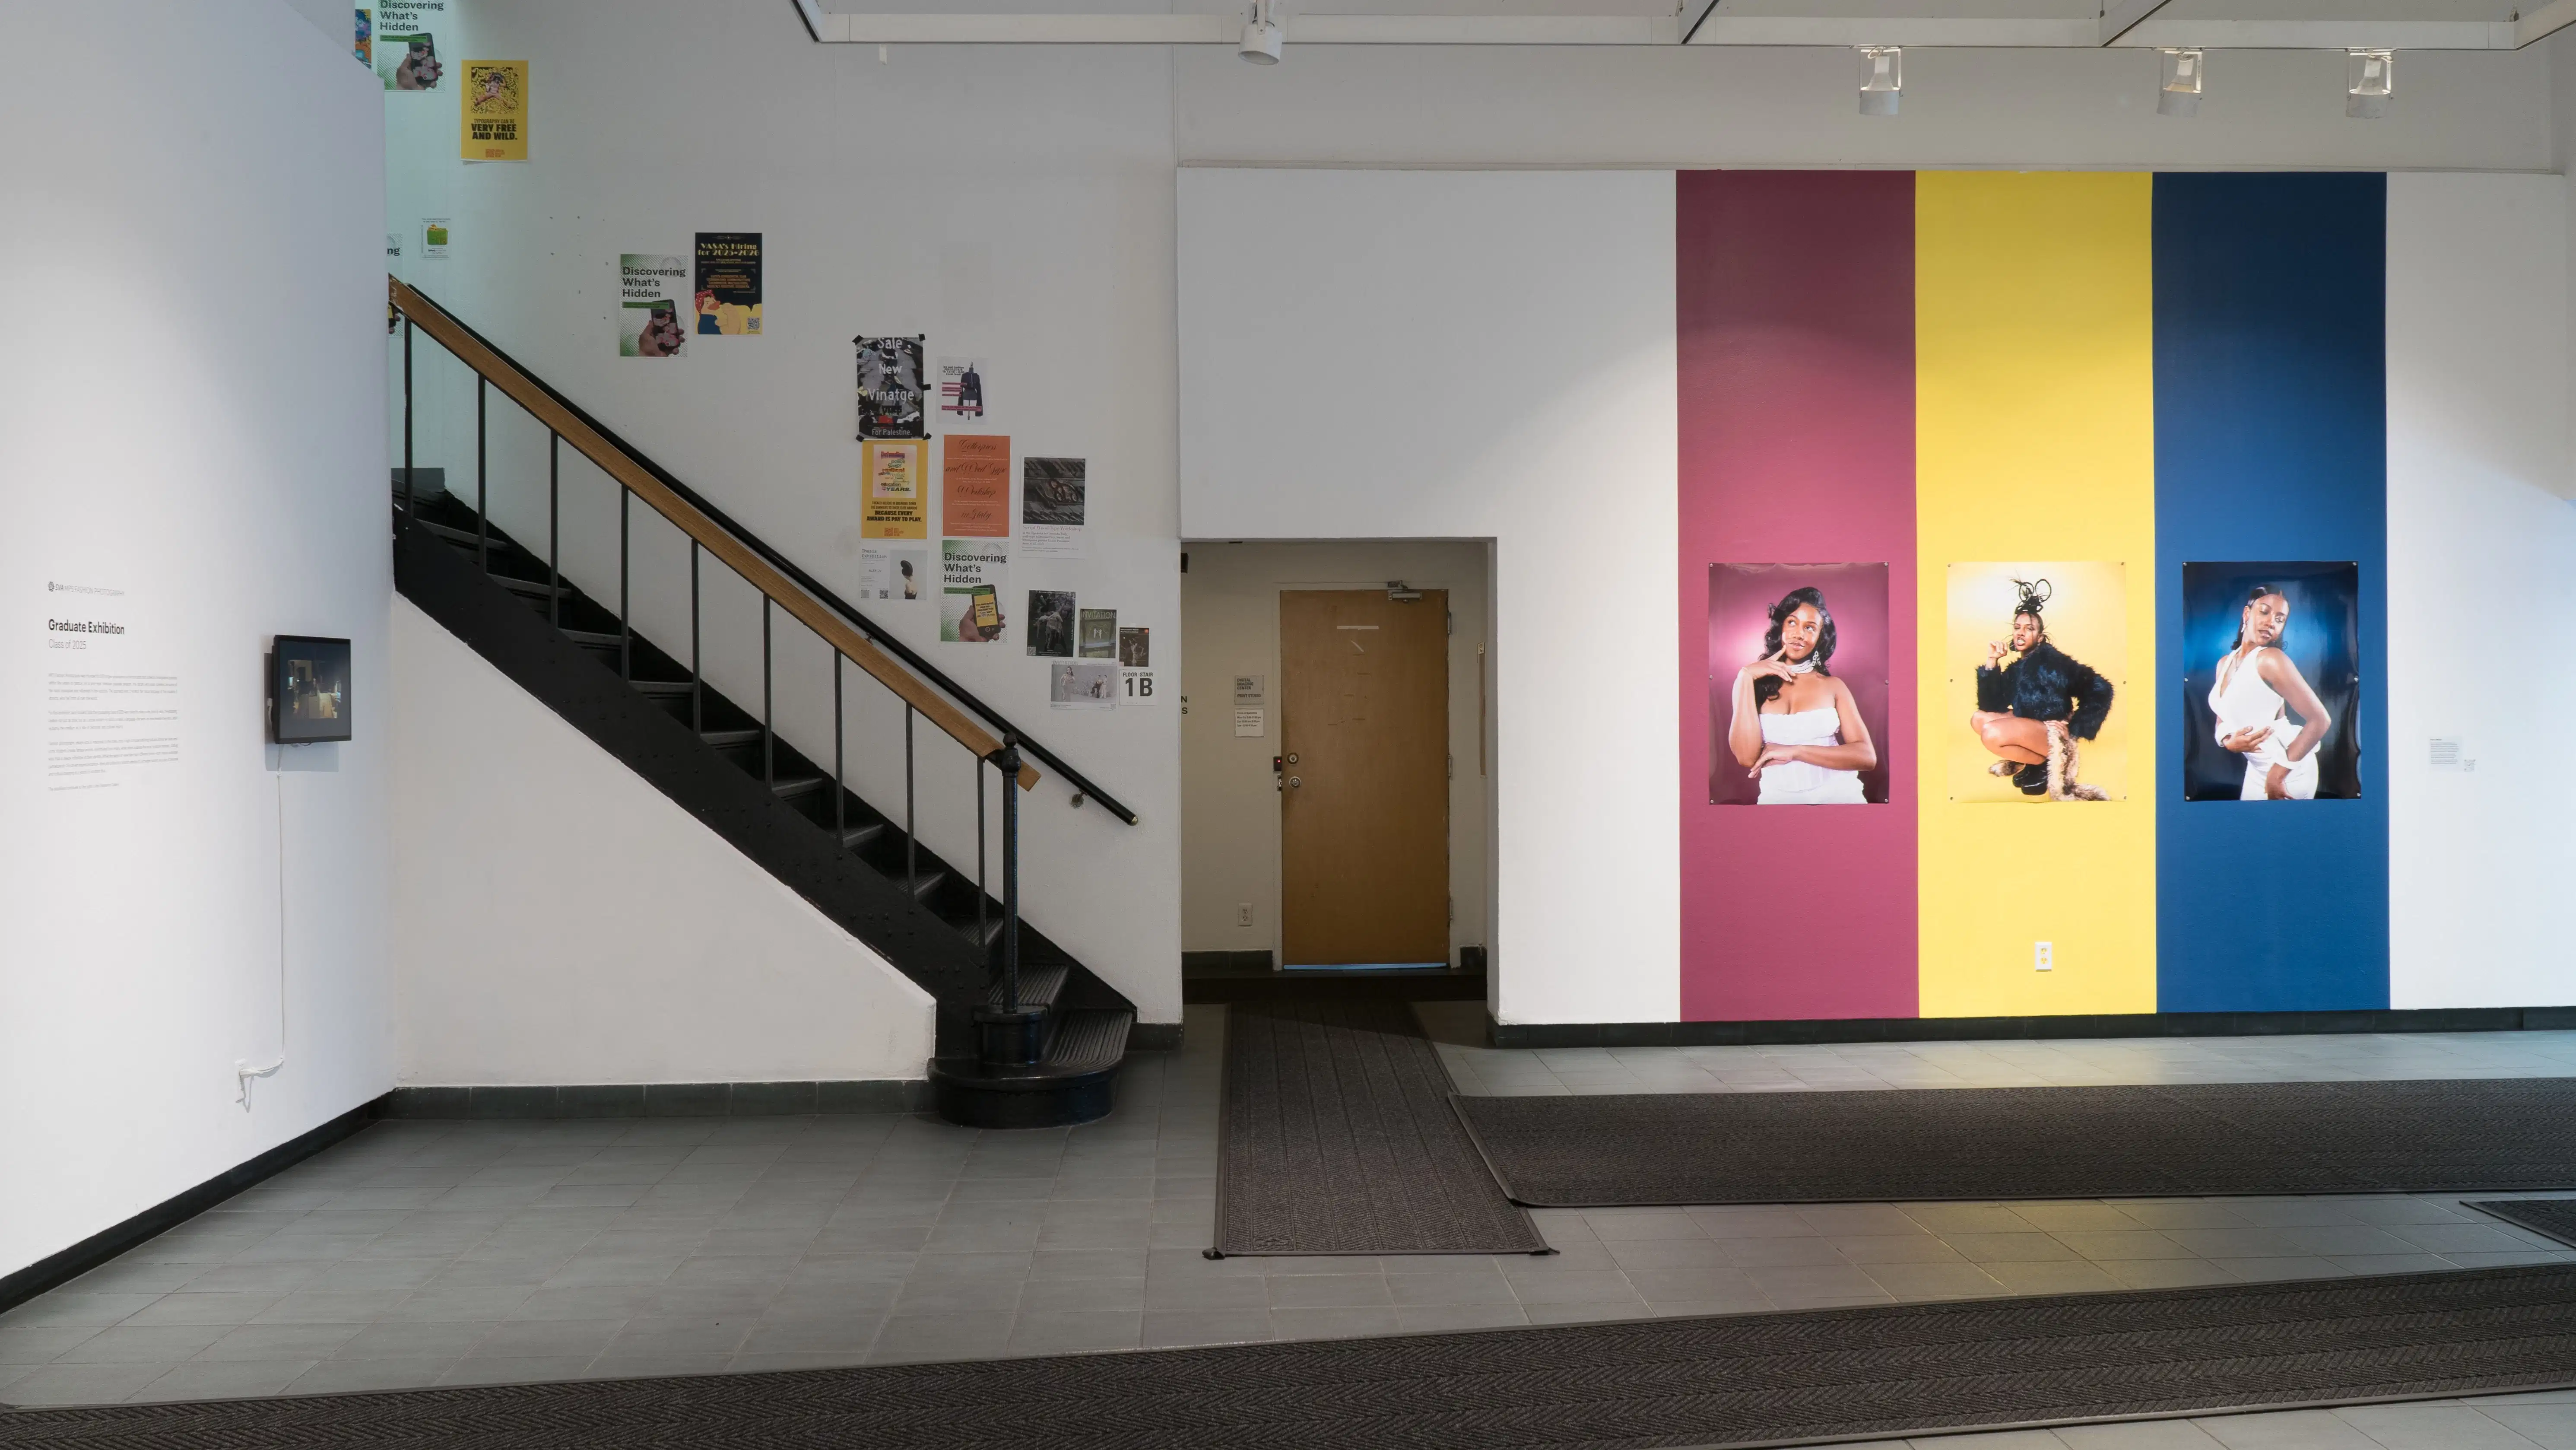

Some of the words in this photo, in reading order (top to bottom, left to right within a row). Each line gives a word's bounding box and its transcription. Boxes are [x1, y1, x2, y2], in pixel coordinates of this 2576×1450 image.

[380, 0, 444, 11] Discovering
[380, 11, 418, 20] What's
[380, 22, 419, 31] Hidden
[472, 132, 491, 140] AND
[494, 132, 517, 140] WILD.
[622, 267, 686, 278] Discovering
[622, 278, 660, 287] What's
[622, 289, 660, 298] Hidden
[877, 337, 902, 349] Sale
[879, 363, 902, 375] New
[867, 388, 914, 404] Vinatge
[944, 553, 1007, 563] Discovering
[944, 564, 981, 572] What's
[944, 575, 981, 583] Hidden
[94, 588, 124, 596] PHOTOGRAPHY
[48, 619, 86, 633] Graduate
[88, 621, 125, 635] Exhibition
[49, 639, 64, 649] Class
[65, 639, 71, 649] of
[72, 640, 87, 649] 2025
[1125, 678, 1133, 696] 1
[1140, 678, 1153, 697] B
